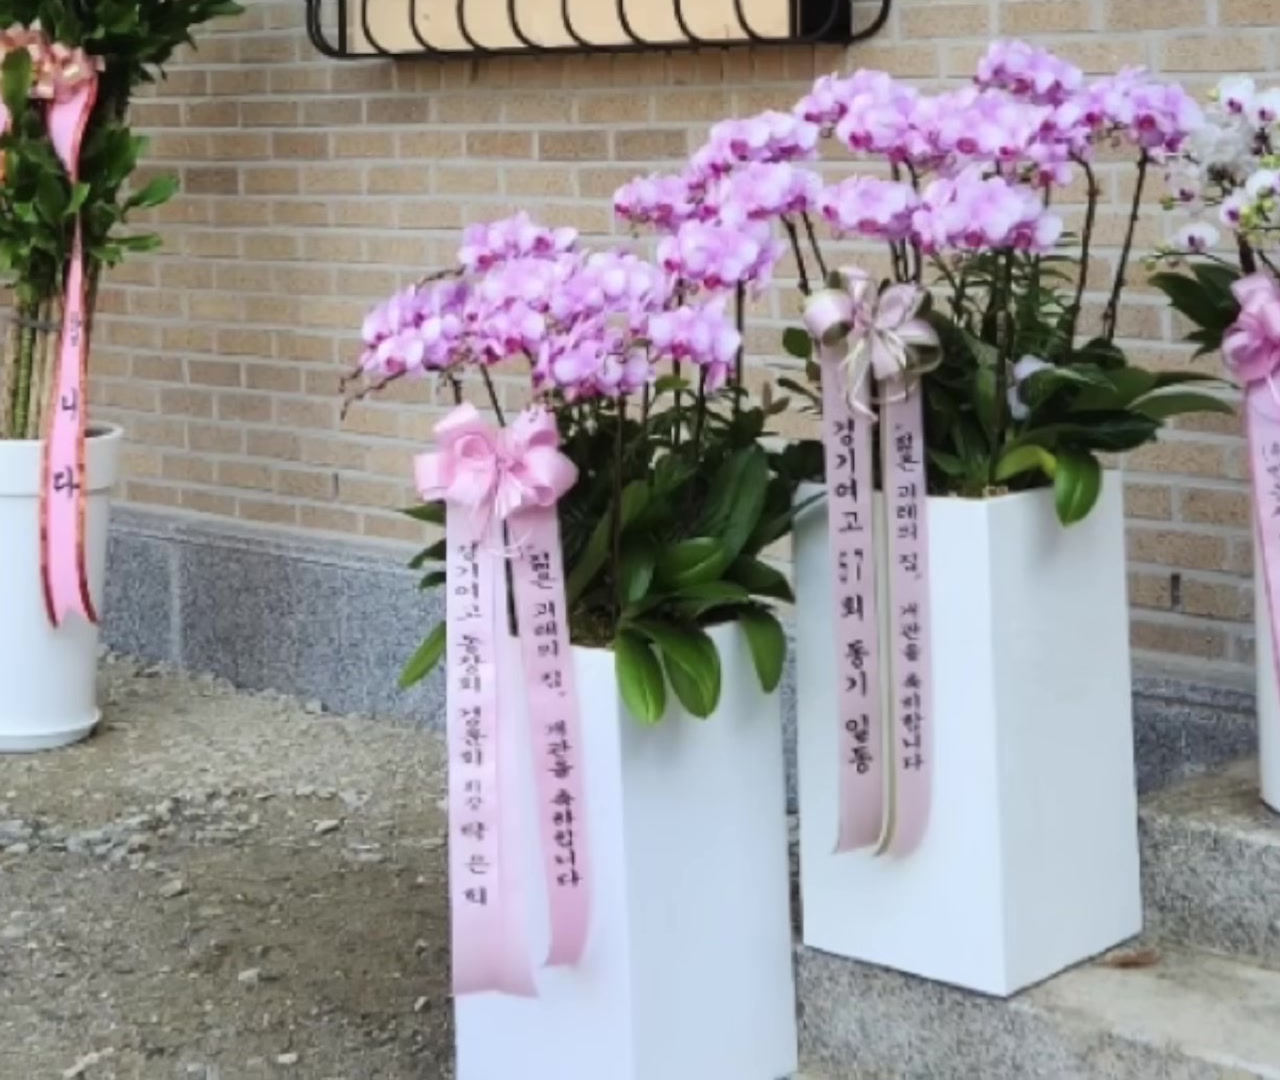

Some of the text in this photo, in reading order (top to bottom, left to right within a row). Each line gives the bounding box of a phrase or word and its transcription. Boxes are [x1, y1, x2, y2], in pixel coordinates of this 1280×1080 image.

[834, 418, 864, 534] 경기여고
[455, 540, 483, 621] 경기여고
[845, 639, 871, 698] 동기
[845, 713, 873, 775] 일동
